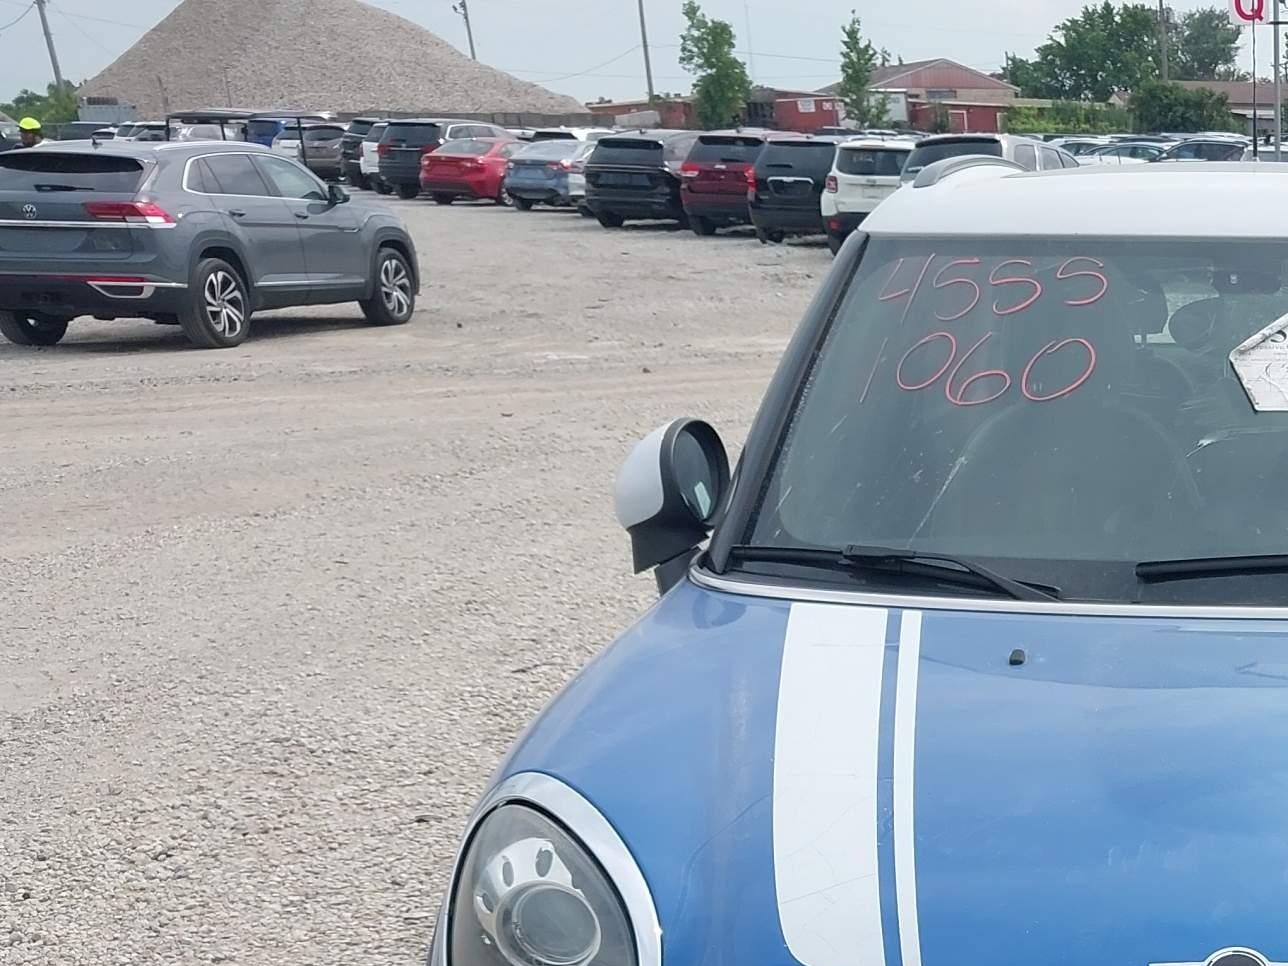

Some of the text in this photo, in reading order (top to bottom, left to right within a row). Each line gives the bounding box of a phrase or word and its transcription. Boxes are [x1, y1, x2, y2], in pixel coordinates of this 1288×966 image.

[1234, 0, 1264, 21] Q
[879, 252, 1108, 323] 4555
[859, 331, 1096, 406] 1060
